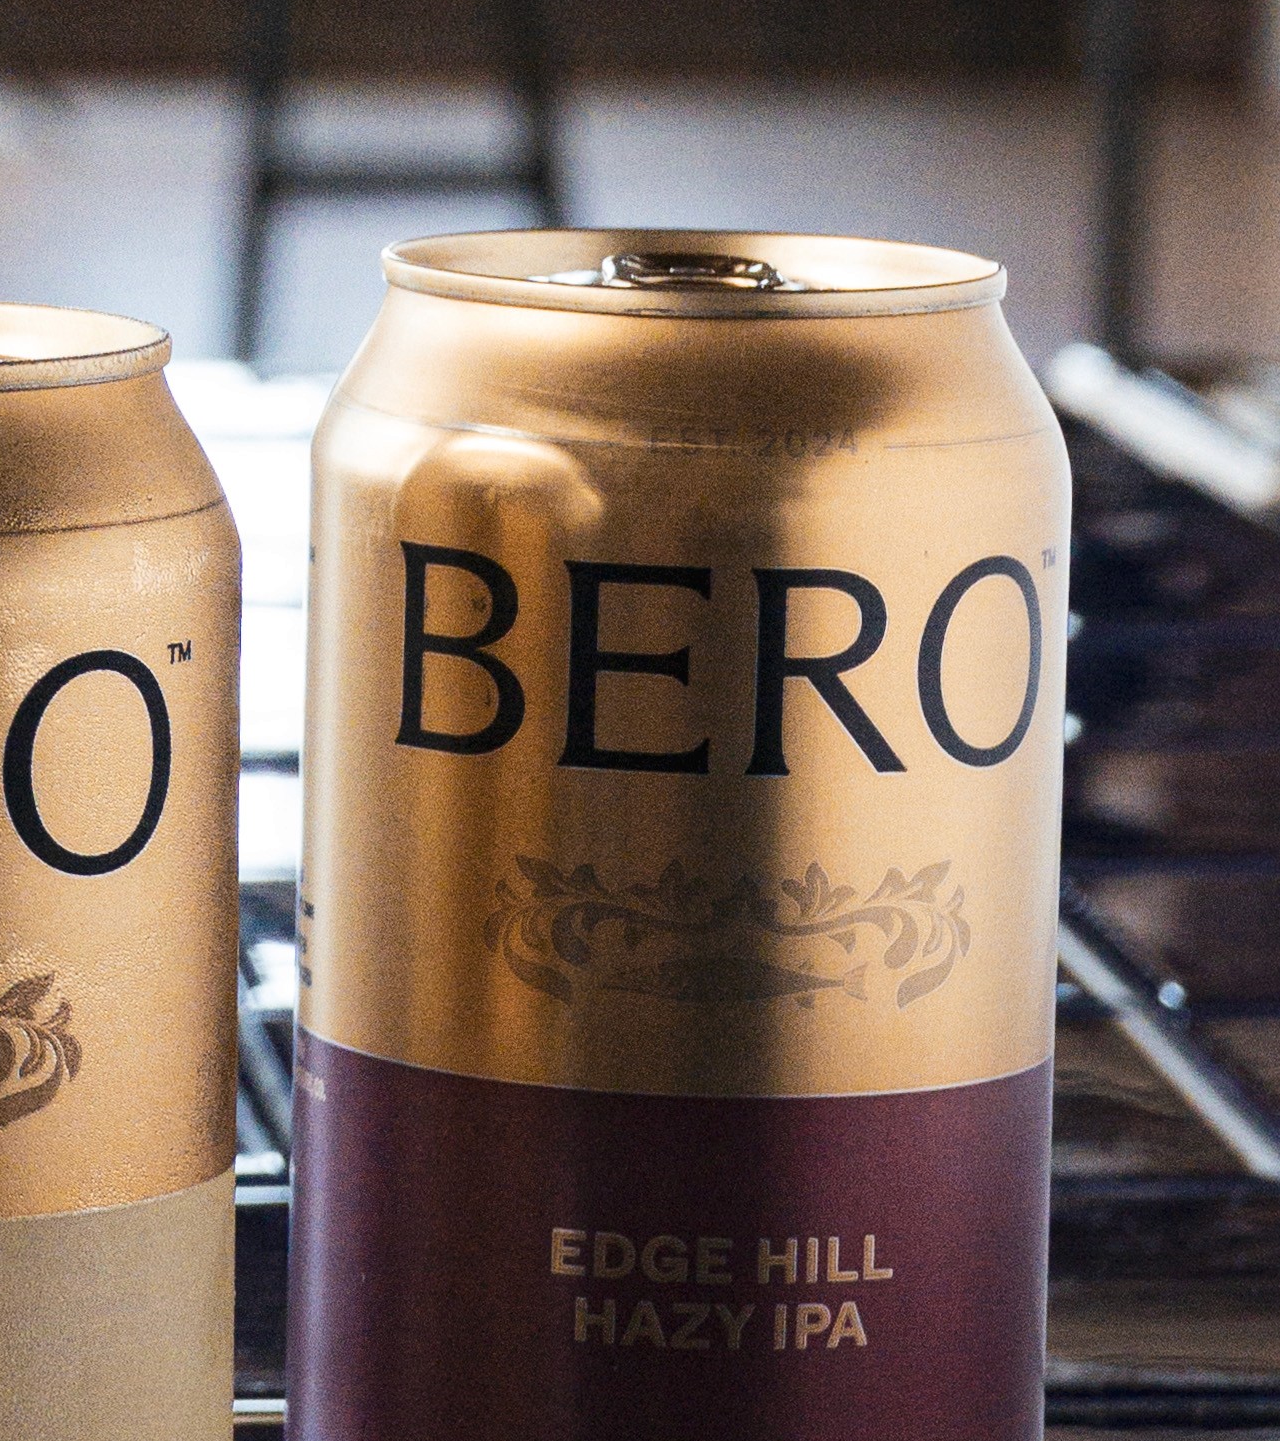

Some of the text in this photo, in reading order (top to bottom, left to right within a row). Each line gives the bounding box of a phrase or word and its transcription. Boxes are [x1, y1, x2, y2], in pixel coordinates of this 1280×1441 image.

[756, 423, 858, 458] 2024
[394, 540, 1041, 777] BERO
[550, 1227, 895, 1286] EDGE HILL
[573, 1297, 868, 1352] HAZY IPA
